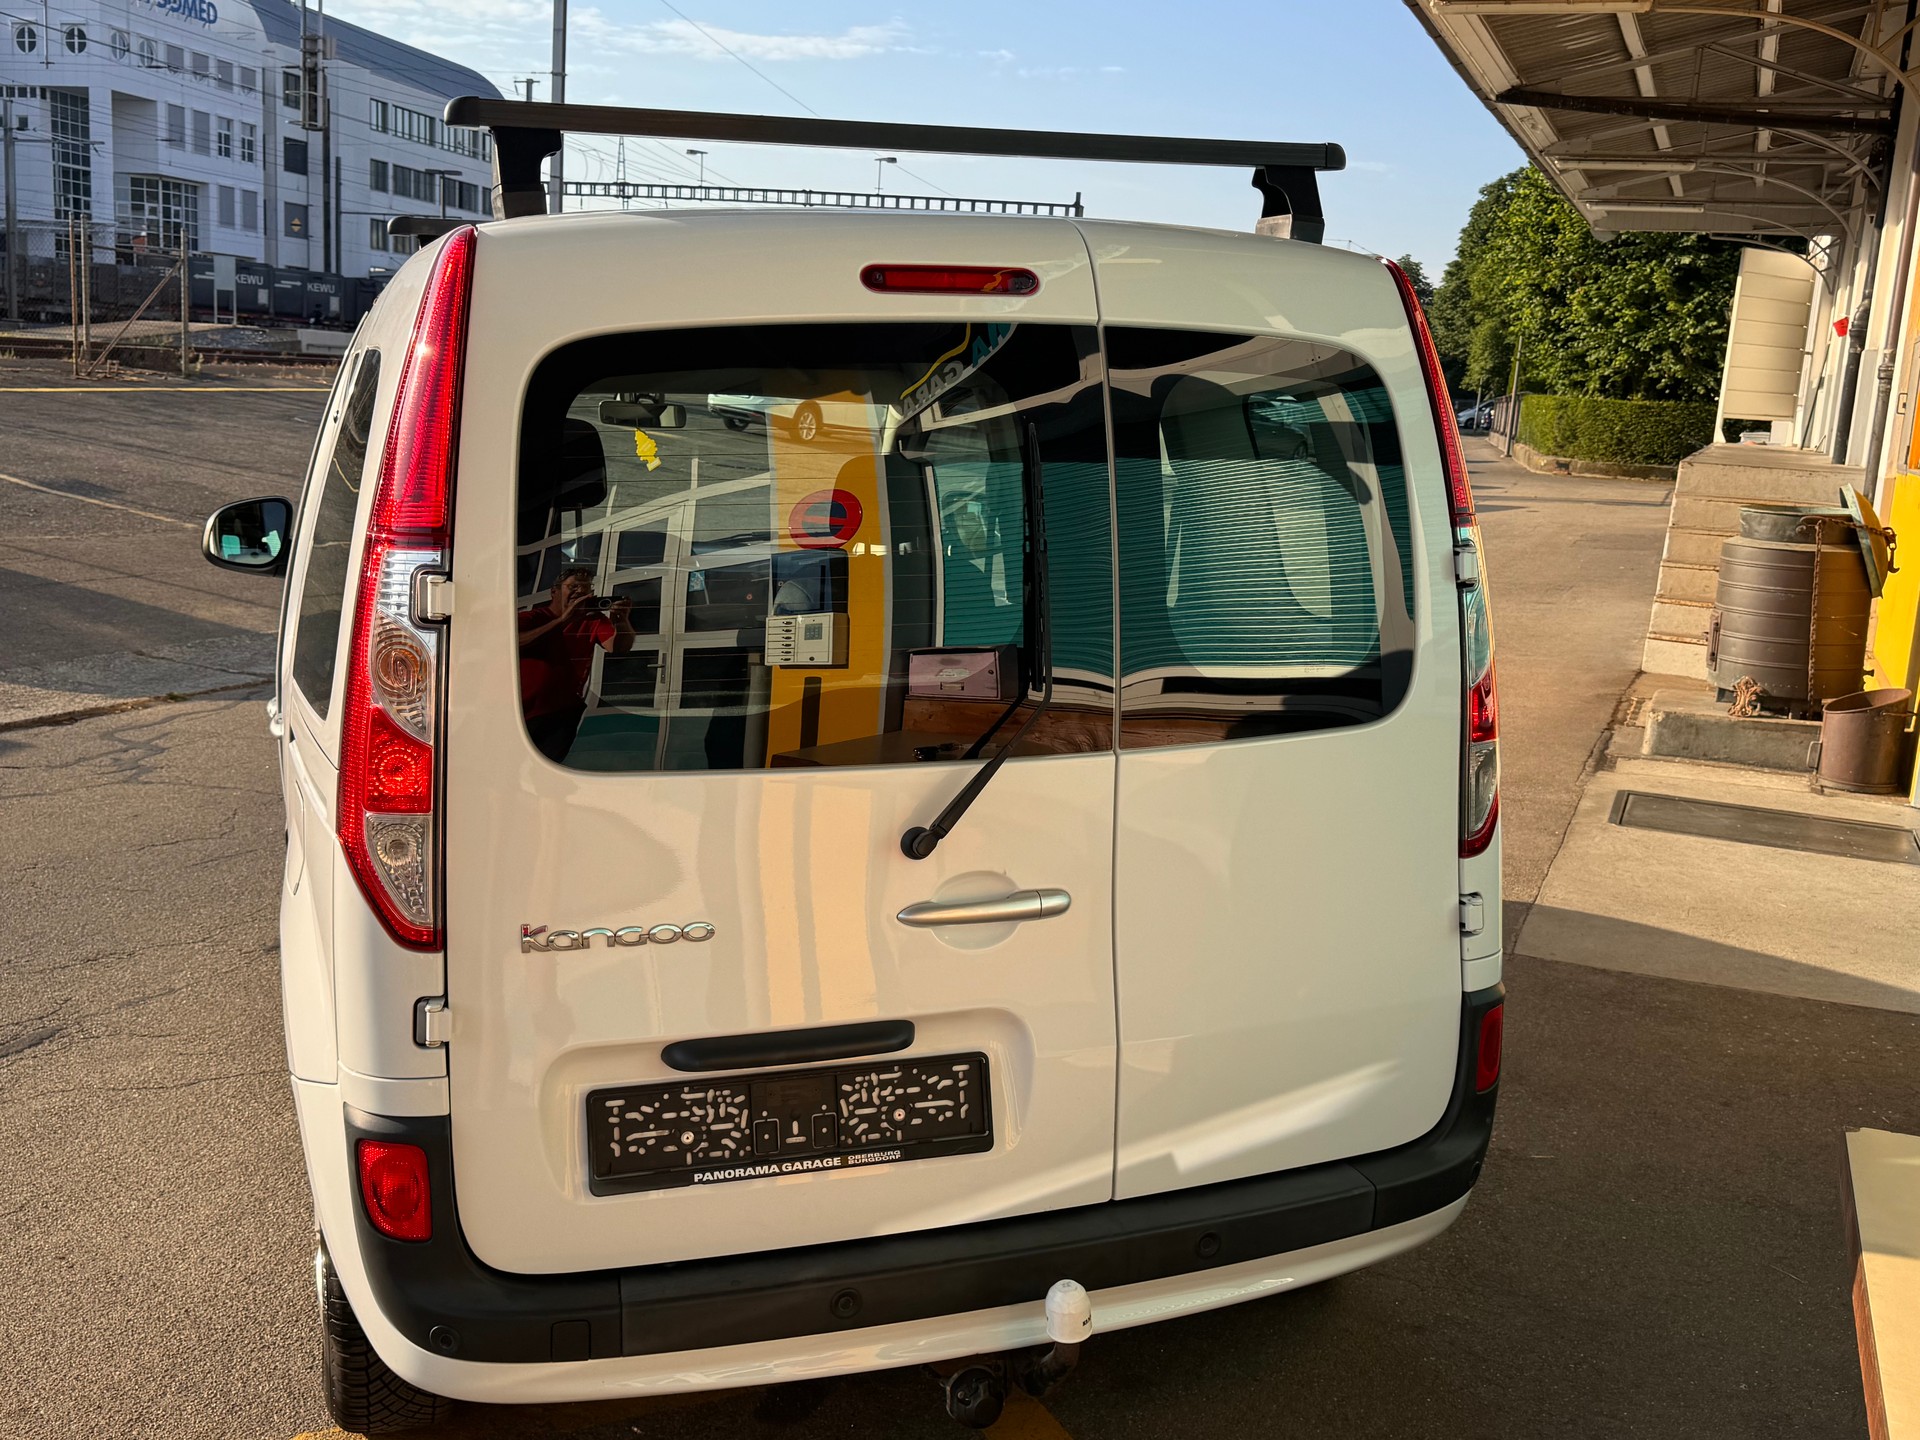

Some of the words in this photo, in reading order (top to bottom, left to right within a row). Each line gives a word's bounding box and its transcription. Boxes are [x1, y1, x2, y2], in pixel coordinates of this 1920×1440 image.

[306, 282, 336, 294] KEWU
[847, 1149, 901, 1160] OBERBURG
[848, 1154, 901, 1165] BURGDORF
[693, 1163, 780, 1183] PANORAMA
[781, 1156, 842, 1173] GARAGE
